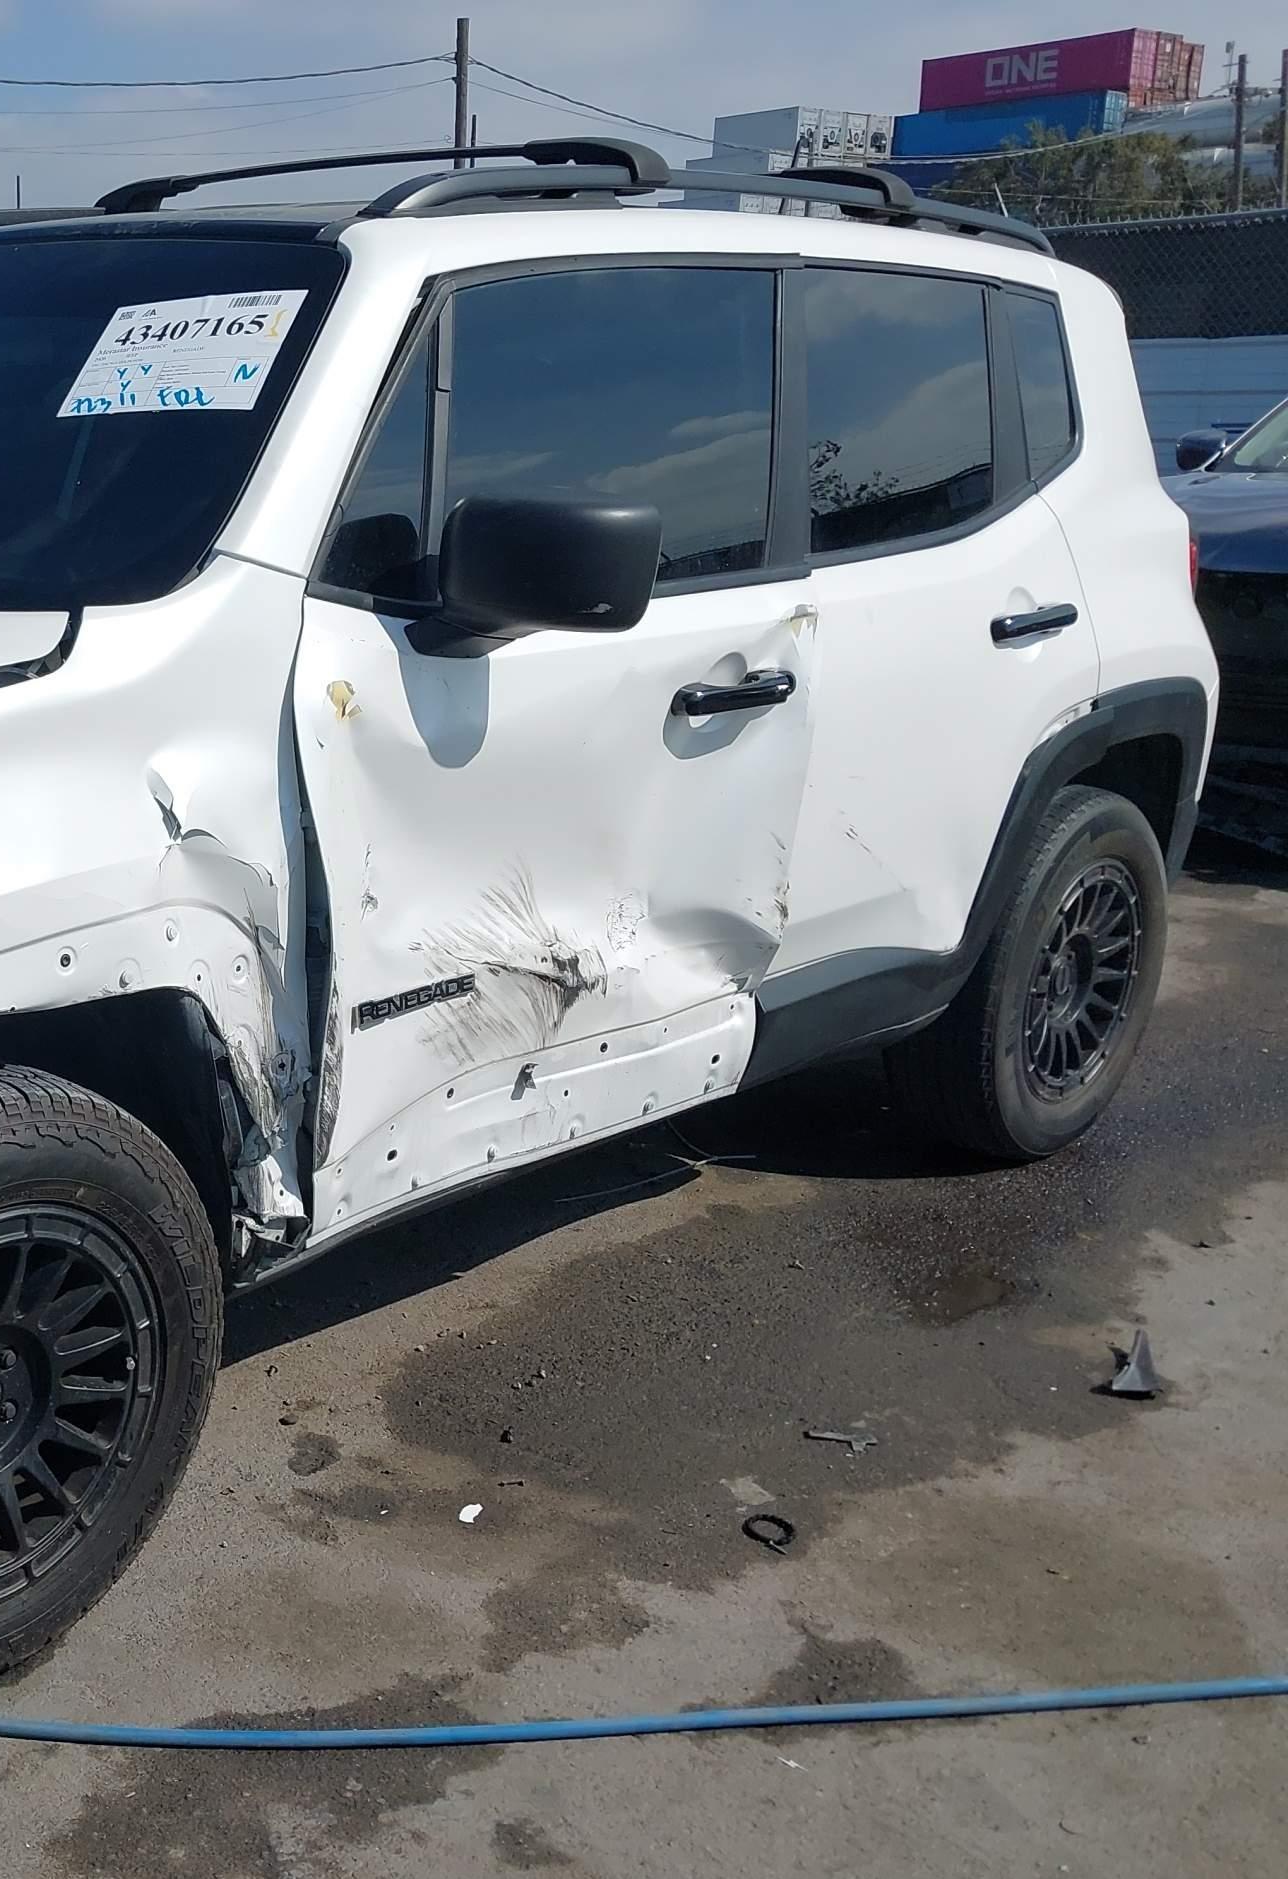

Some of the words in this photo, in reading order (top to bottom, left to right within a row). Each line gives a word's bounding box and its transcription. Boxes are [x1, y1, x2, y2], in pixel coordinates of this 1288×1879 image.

[985, 50, 1059, 88] ONE
[114, 313, 269, 346] 43407165
[132, 343, 168, 353] Insurance
[234, 363, 261, 383] N
[352, 973, 476, 1033] RENEGADE
[148, 1205, 210, 1478] WILDPEAK
